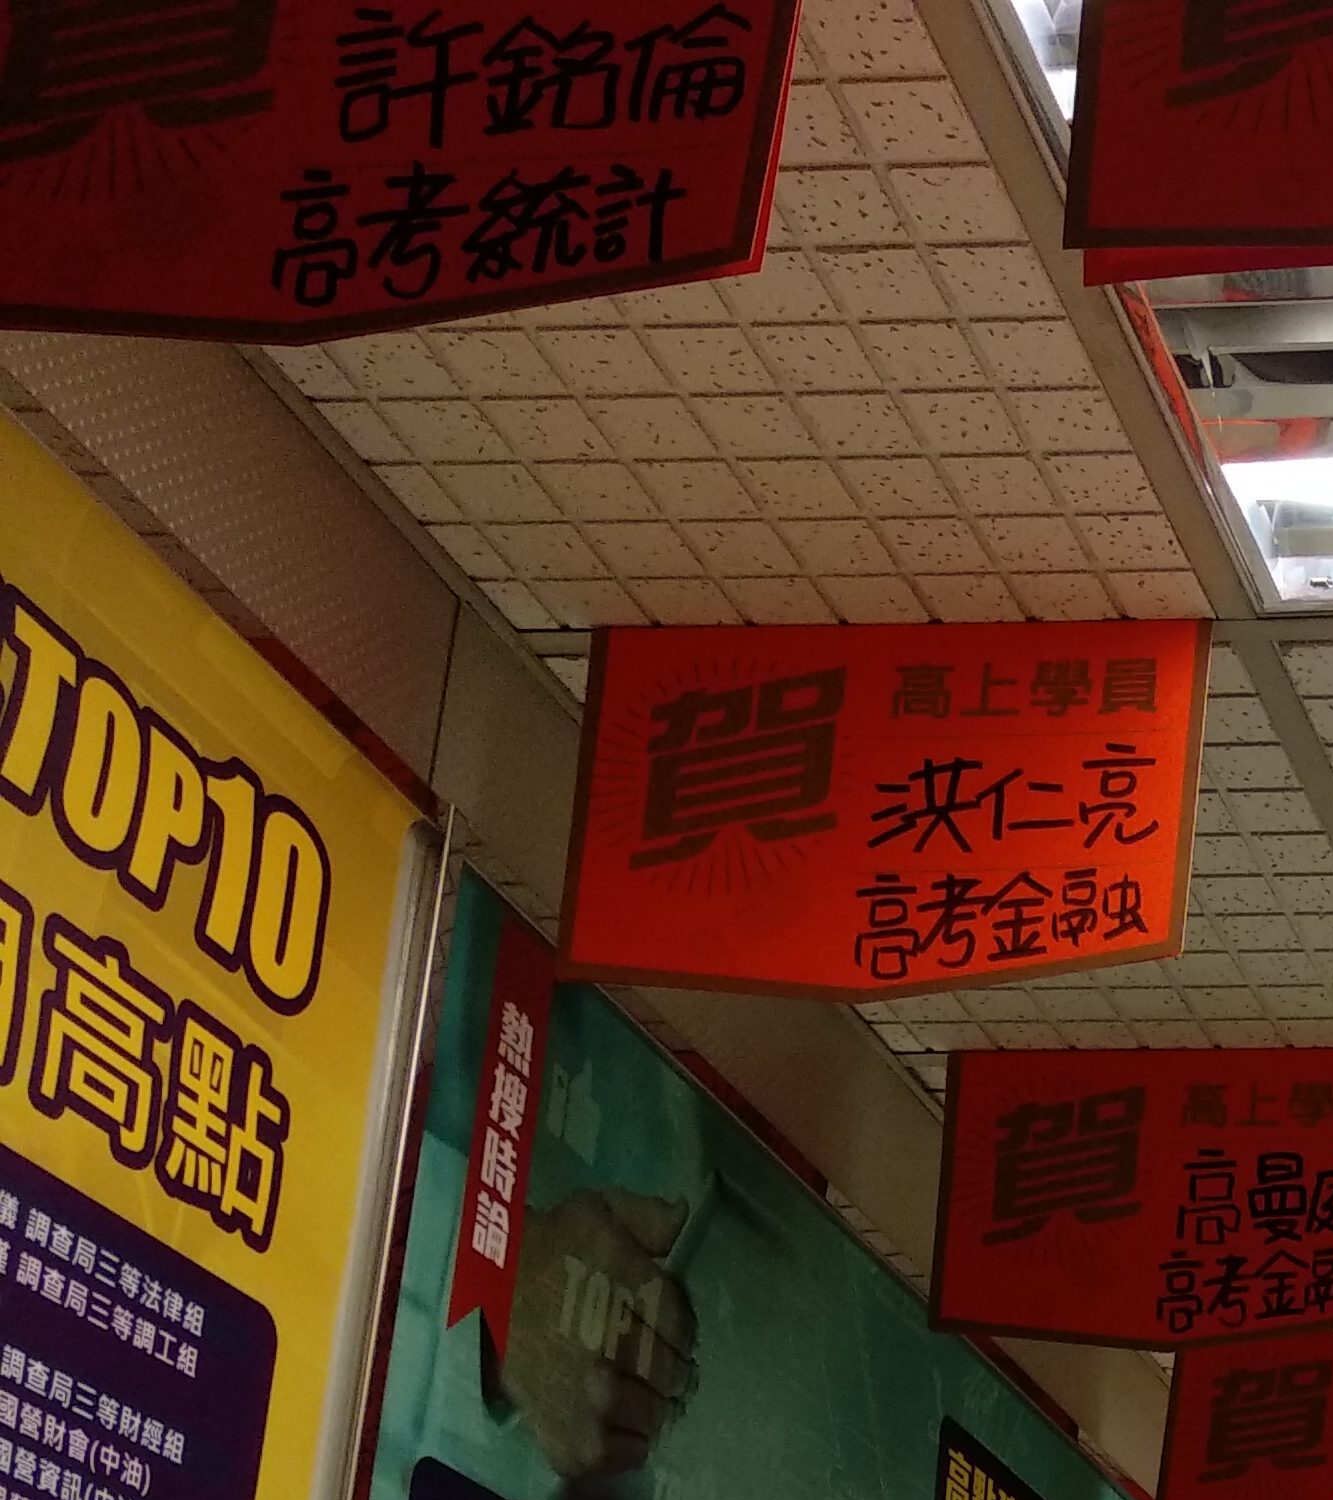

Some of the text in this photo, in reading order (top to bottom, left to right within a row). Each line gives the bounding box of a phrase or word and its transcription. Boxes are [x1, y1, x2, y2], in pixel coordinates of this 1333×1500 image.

[337, 3, 752, 148] 許銘倫
[272, 160, 686, 306] 高考統計
[890, 659, 1157, 718] 高上學員
[5, 600, 328, 1002] TOP10
[631, 667, 847, 870] 賀
[868, 743, 1158, 853] 洪仁亮
[854, 868, 1148, 979] 高考金融
[45, 920, 285, 1240] 高點
[982, 1086, 1146, 1246] 賀
[15, 1251, 200, 1379] 調查局三等調工組
[25, 1207, 206, 1338] 調查局三等法律組
[0, 1343, 187, 1466] 調查局三等財經組
